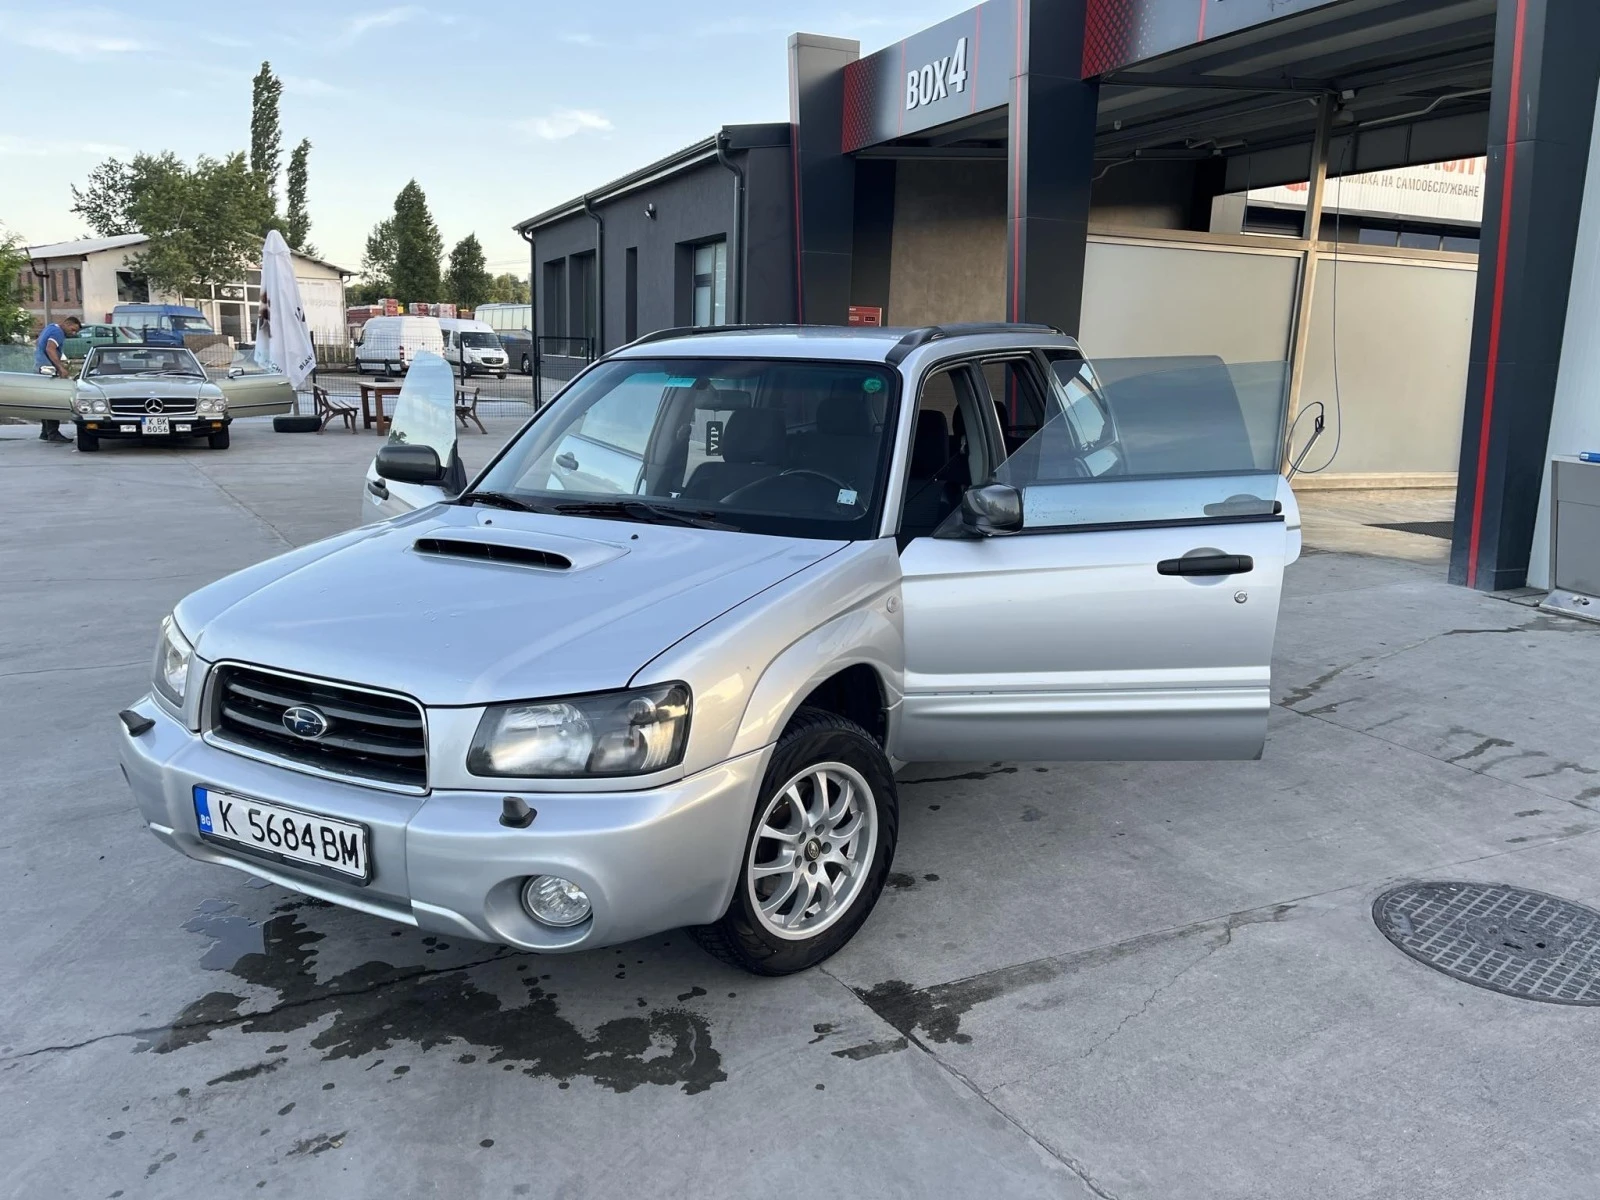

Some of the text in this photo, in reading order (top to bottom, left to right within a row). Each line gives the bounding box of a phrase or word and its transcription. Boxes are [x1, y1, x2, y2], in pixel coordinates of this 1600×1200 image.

[1381, 175, 1394, 187] НА
[1396, 176, 1480, 197] САМООБСЛУЖВАНЕ
[147, 425, 168, 433] 8056
[148, 417, 154, 425] K
[710, 426, 719, 451] VIP
[200, 814, 211, 826] BG
[219, 800, 238, 836] K
